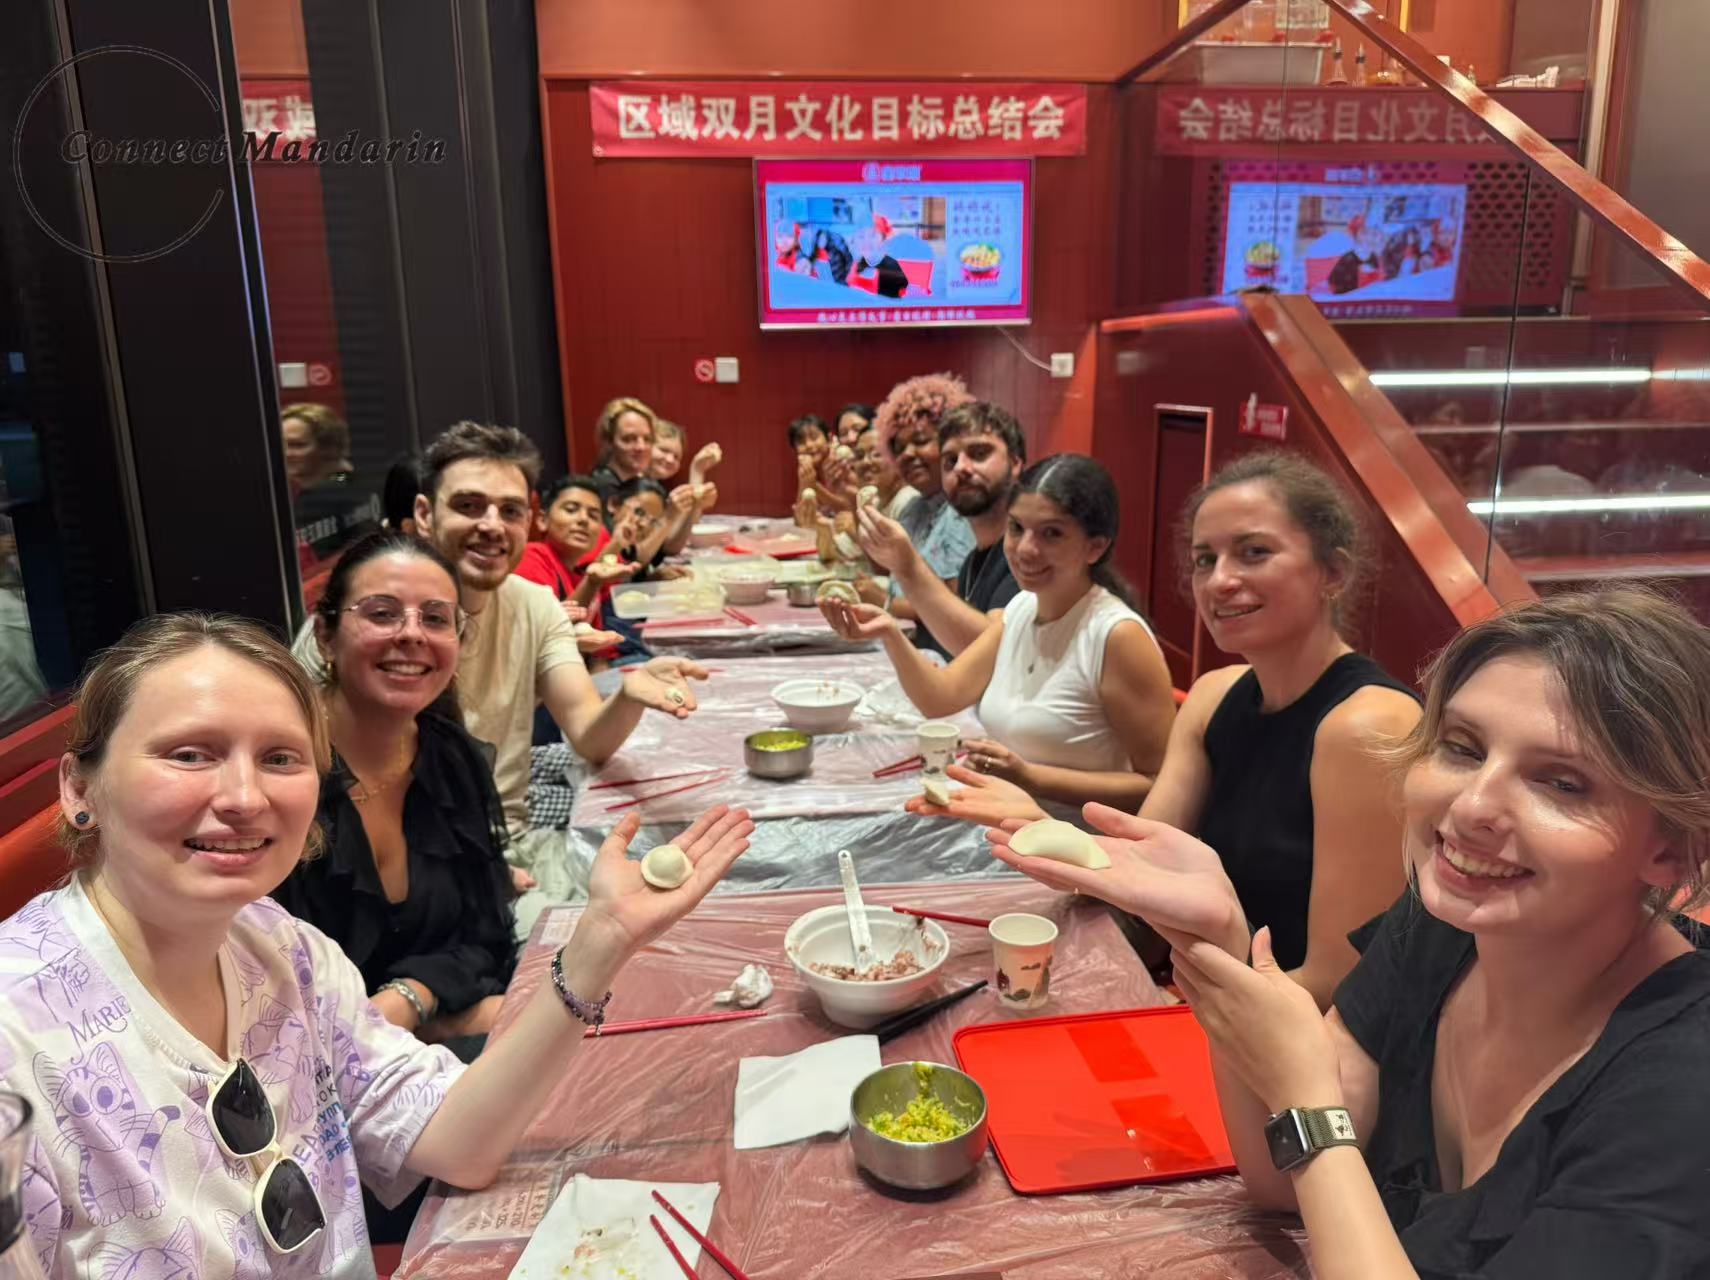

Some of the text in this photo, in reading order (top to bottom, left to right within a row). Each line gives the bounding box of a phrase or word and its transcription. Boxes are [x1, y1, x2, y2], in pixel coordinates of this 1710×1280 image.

[617, 93, 1065, 141] 区域双月文化目标总结会
[67, 995, 132, 1065] MARIE
